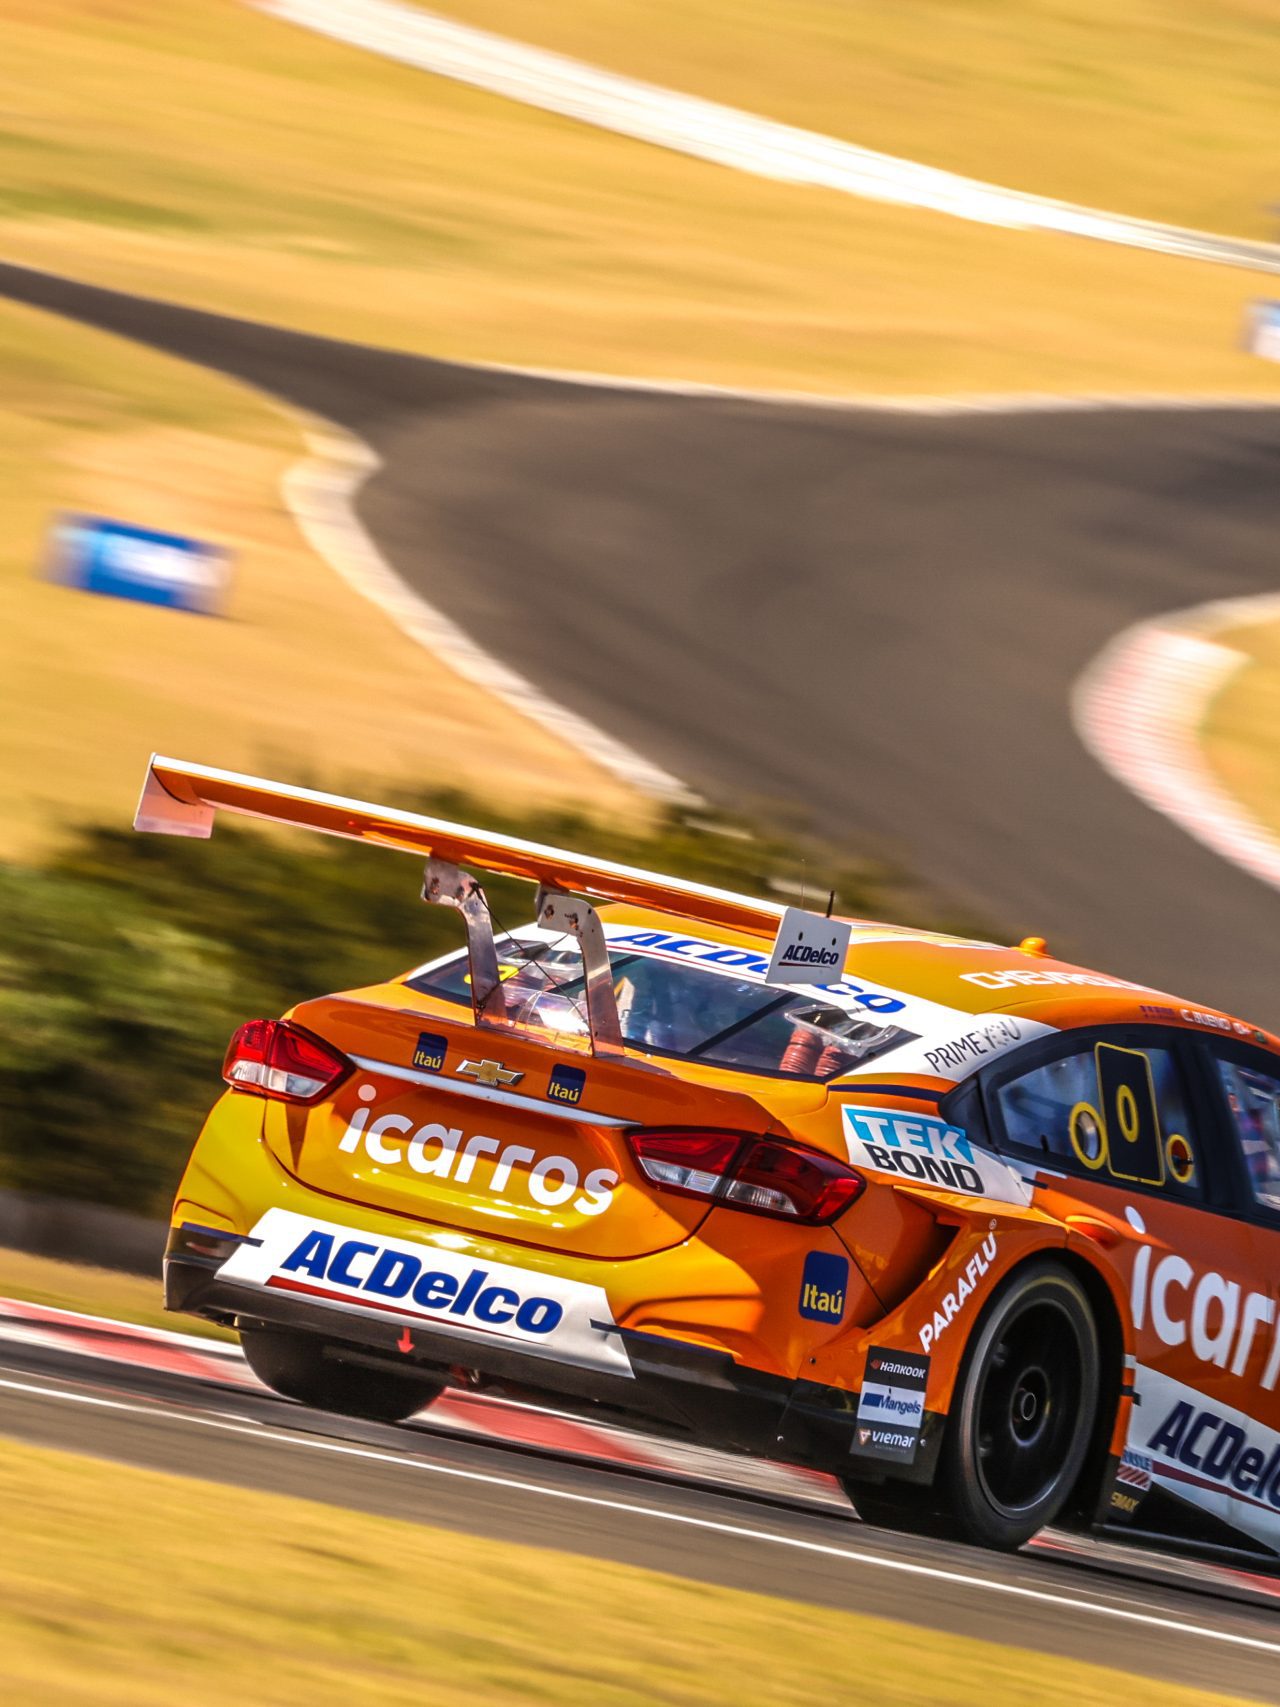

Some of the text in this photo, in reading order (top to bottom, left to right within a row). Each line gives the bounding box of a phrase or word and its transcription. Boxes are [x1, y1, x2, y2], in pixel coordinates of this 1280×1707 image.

[605, 932, 906, 1013] ACDco
[782, 944, 839, 966] ACDelco
[414, 1051, 442, 1069] Itaú
[923, 1018, 1022, 1073] PRIMEYOU
[549, 1082, 580, 1102] Itaú
[338, 1084, 619, 1216] icarros
[854, 1114, 966, 1165] TEK
[862, 1142, 985, 1194] BOND
[280, 1229, 564, 1334] ACDelco
[803, 1283, 843, 1315] Itaú
[919, 1231, 997, 1353] PARAFLU
[872, 1430, 915, 1448] viemar
